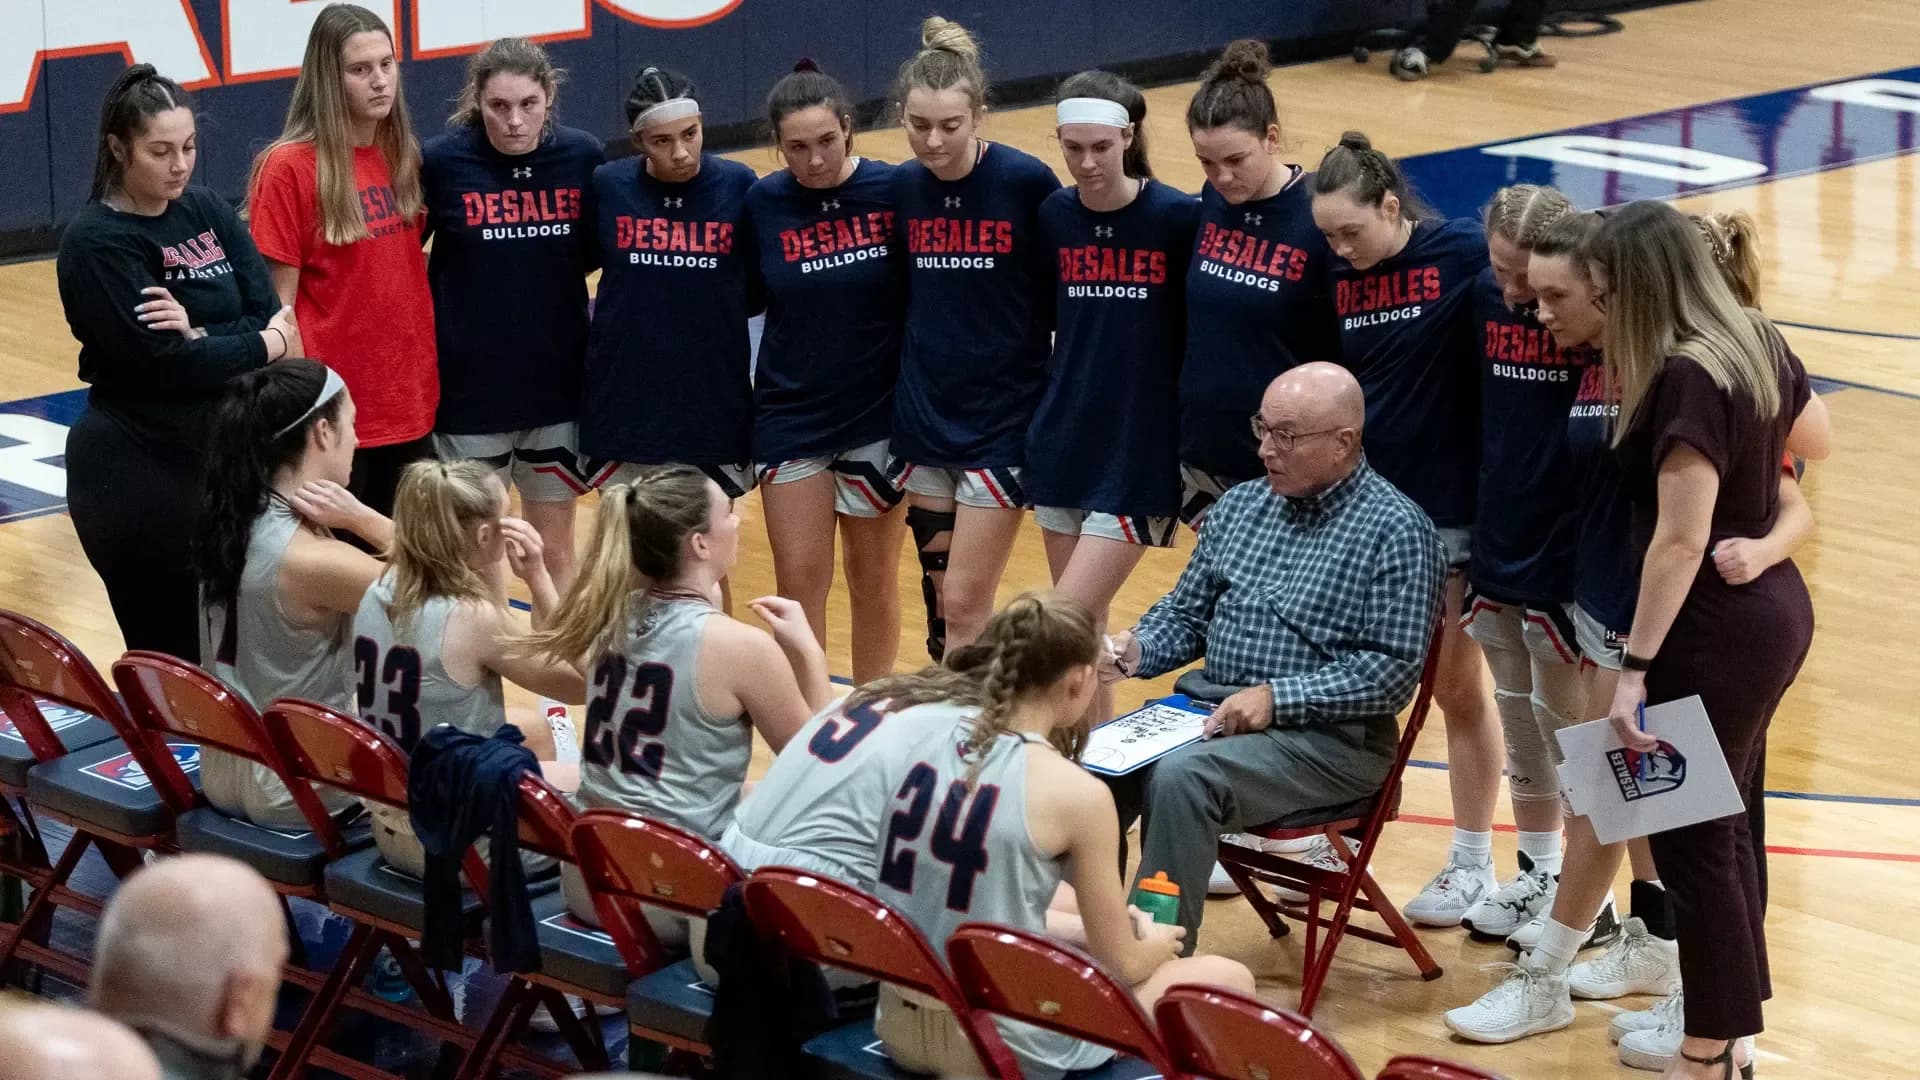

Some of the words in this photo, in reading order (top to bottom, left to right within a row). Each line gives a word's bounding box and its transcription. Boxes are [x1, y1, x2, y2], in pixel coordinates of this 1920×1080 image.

[482, 223, 571, 241] BULLDOGS
[629, 252, 718, 270] BULLDOGS
[801, 244, 889, 275] BULLDOGS
[916, 256, 995, 270] BULLDOGS
[1200, 259, 1281, 293] BULLDOGS
[1067, 284, 1149, 300] BULLDOGS
[1344, 305, 1423, 331] BULLDOGS
[1492, 362, 1570, 383] BULLDOGS
[354, 634, 423, 757] 23
[583, 652, 674, 780] 22
[1611, 752, 1639, 800] DESALES
[879, 760, 1001, 914] 24
